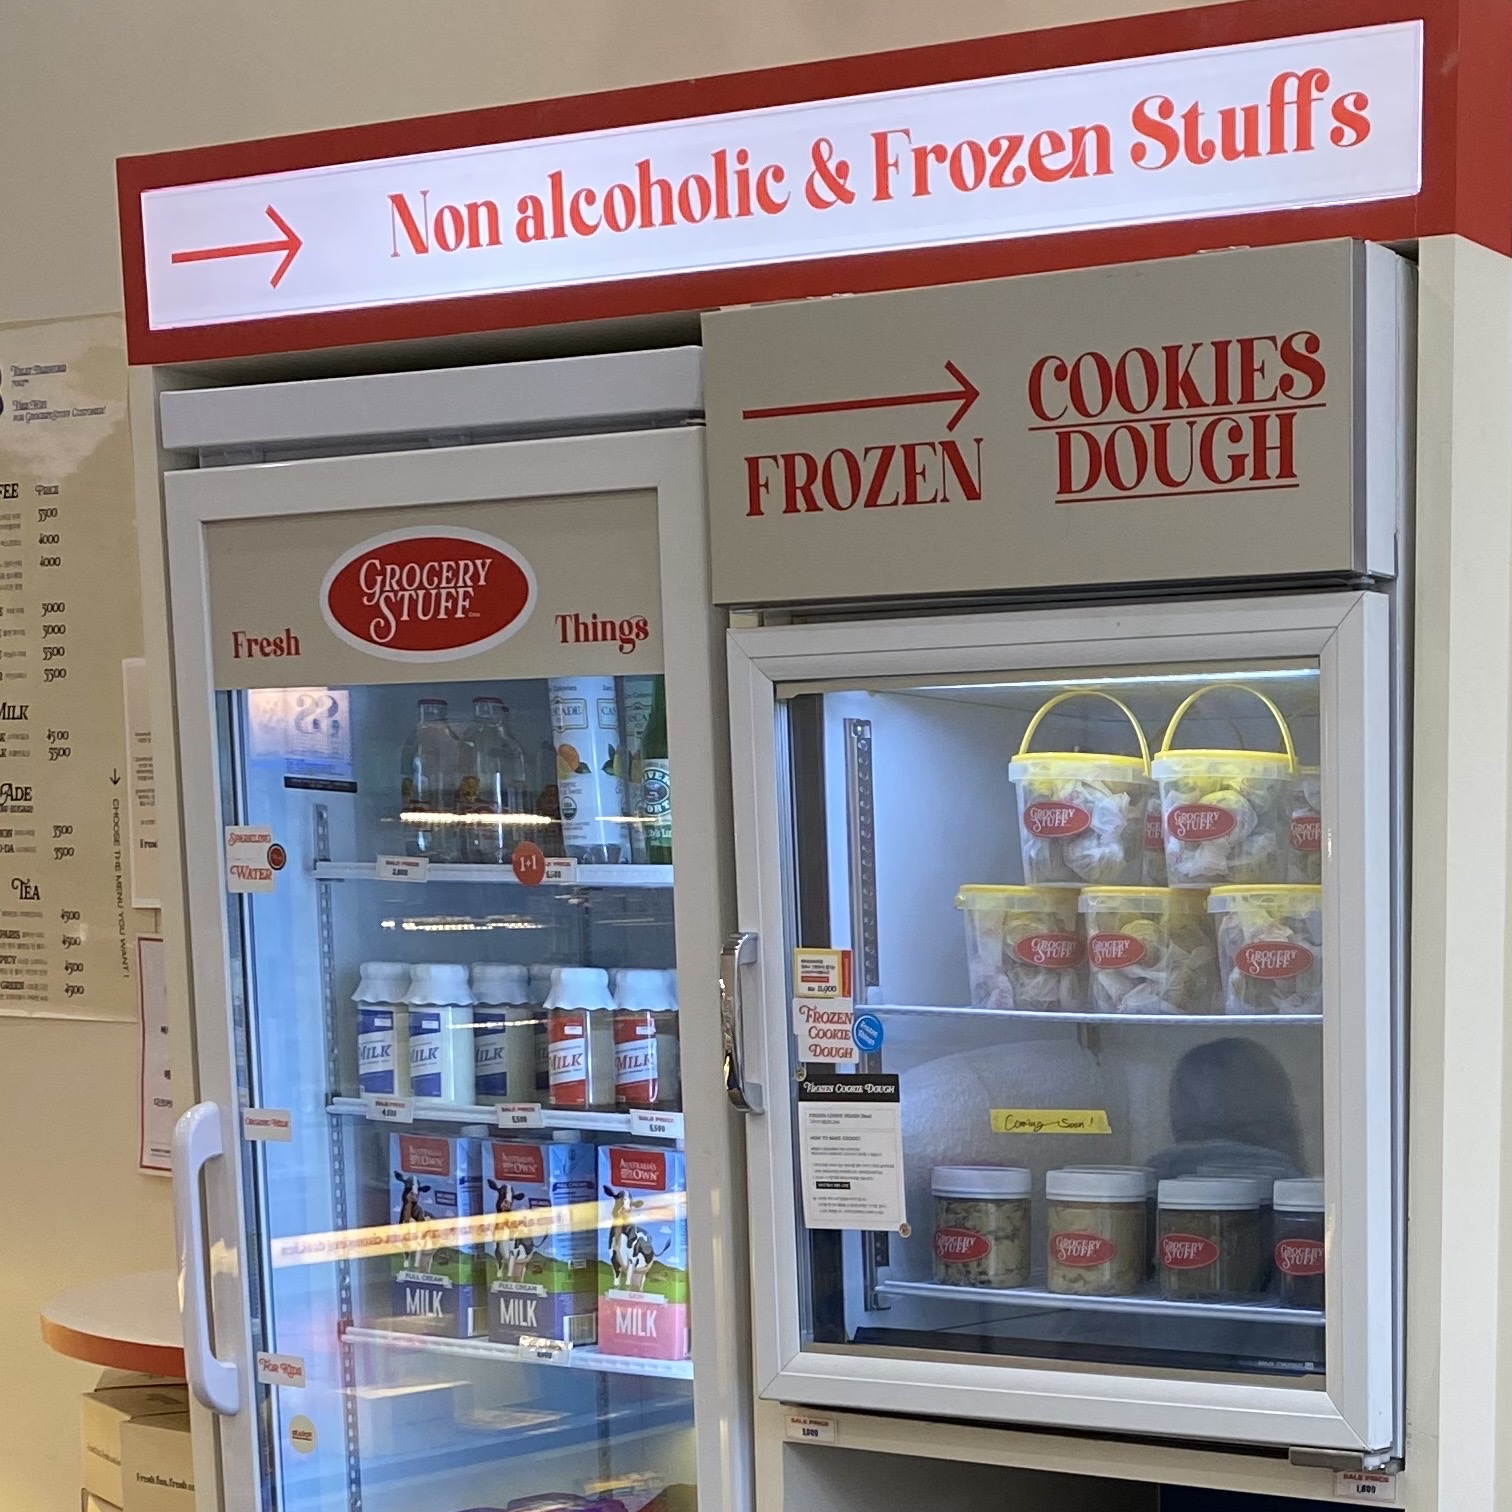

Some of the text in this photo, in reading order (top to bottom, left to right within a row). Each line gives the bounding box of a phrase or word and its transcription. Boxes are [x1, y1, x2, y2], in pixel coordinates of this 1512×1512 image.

[389, 191, 501, 258] Non
[516, 144, 792, 243] alcoholic
[805, 139, 857, 208] &
[872, 122, 1113, 201] Frozen
[1028, 331, 1326, 422] COOKIES
[1055, 412, 1298, 494] DOUGH
[744, 438, 983, 516] FROZEN
[358, 558, 492, 606] GROCERY
[369, 587, 475, 643] STUFF
[555, 614, 650, 654] Things
[231, 628, 301, 659] Fresh
[1030, 808, 1075, 826] GROCERY
[1033, 816, 1070, 834] STUFF
[1173, 810, 1219, 828] GROCERY
[1177, 818, 1214, 836] STUFF
[519, 854, 538, 872] 1+1
[230, 865, 272, 881] WATER
[11, 877, 40, 900] TEA
[1245, 948, 1298, 965] GROCERY
[1252, 956, 1290, 974] STUFF
[799, 1005, 854, 1024] FROZEN
[808, 1026, 850, 1040] COOKIE
[359, 1044, 392, 1061] MILK
[809, 1044, 853, 1058] DOUGH
[616, 1052, 654, 1071] MILK
[803, 1081, 895, 1094] FROZEN COOKIE DOUGH
[1004, 1113, 1045, 1132] Coming
[633, 1169, 658, 1181] OWN
[935, 1234, 974, 1248] GROCERY
[936, 1241, 969, 1256] STUFF
[1055, 1237, 1102, 1251] GROCERY
[1163, 1239, 1205, 1254] GROCERY
[1058, 1245, 1094, 1260] STUFF
[1163, 1246, 1197, 1262] STUFF
[1282, 1251, 1318, 1269] STUFF
[516, 1284, 537, 1292] CREAM
[406, 1288, 443, 1317] MILK
[500, 1297, 537, 1328] MILK
[616, 1307, 657, 1337] MILK
[259, 1357, 302, 1379] FOR KIDS
[1343, 1473, 1389, 1483] SALE PRICE
